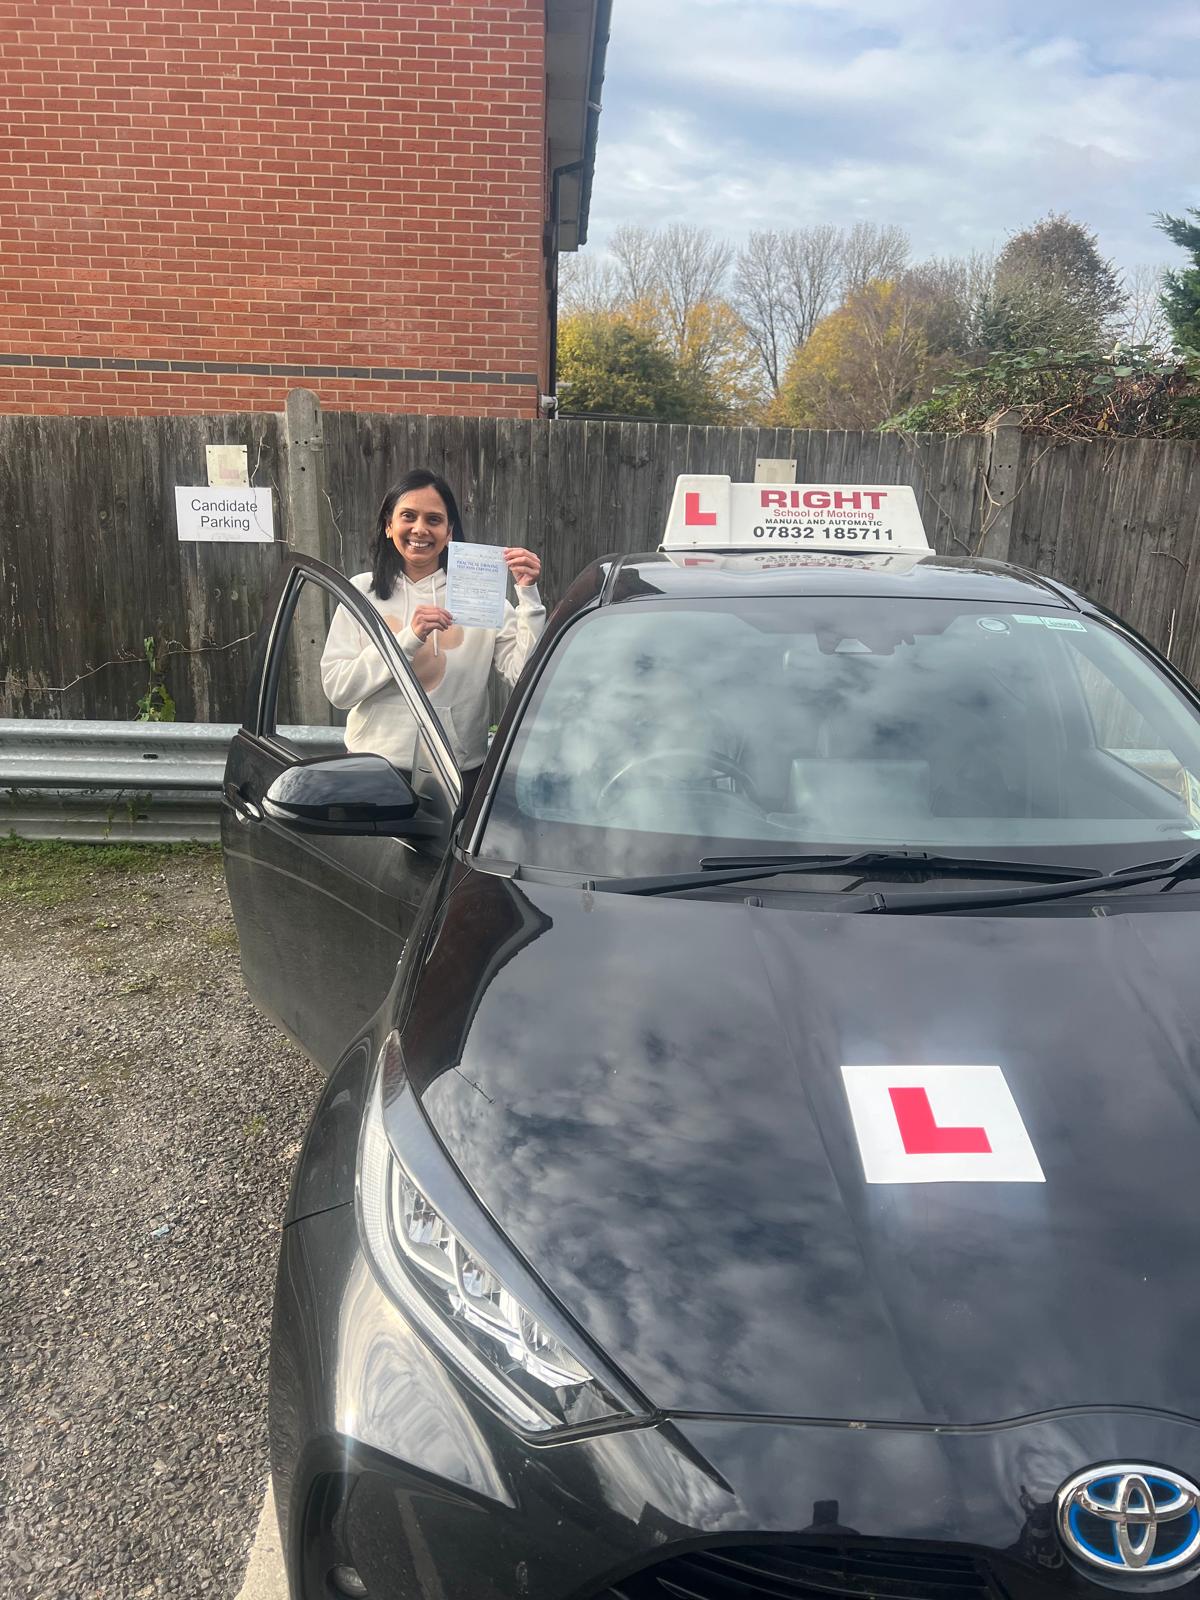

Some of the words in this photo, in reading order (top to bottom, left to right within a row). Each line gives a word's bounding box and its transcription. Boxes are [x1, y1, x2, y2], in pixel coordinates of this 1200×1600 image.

[191, 499, 258, 513] Candidate
[760, 490, 888, 510] RIGHT
[685, 492, 717, 525] L
[773, 509, 810, 517] School
[813, 509, 824, 517] of
[827, 510, 875, 520] Motoring
[200, 515, 250, 531] Parking
[753, 526, 814, 539] 07832
[822, 527, 893, 541] 185711
[888, 1087, 993, 1155] L
